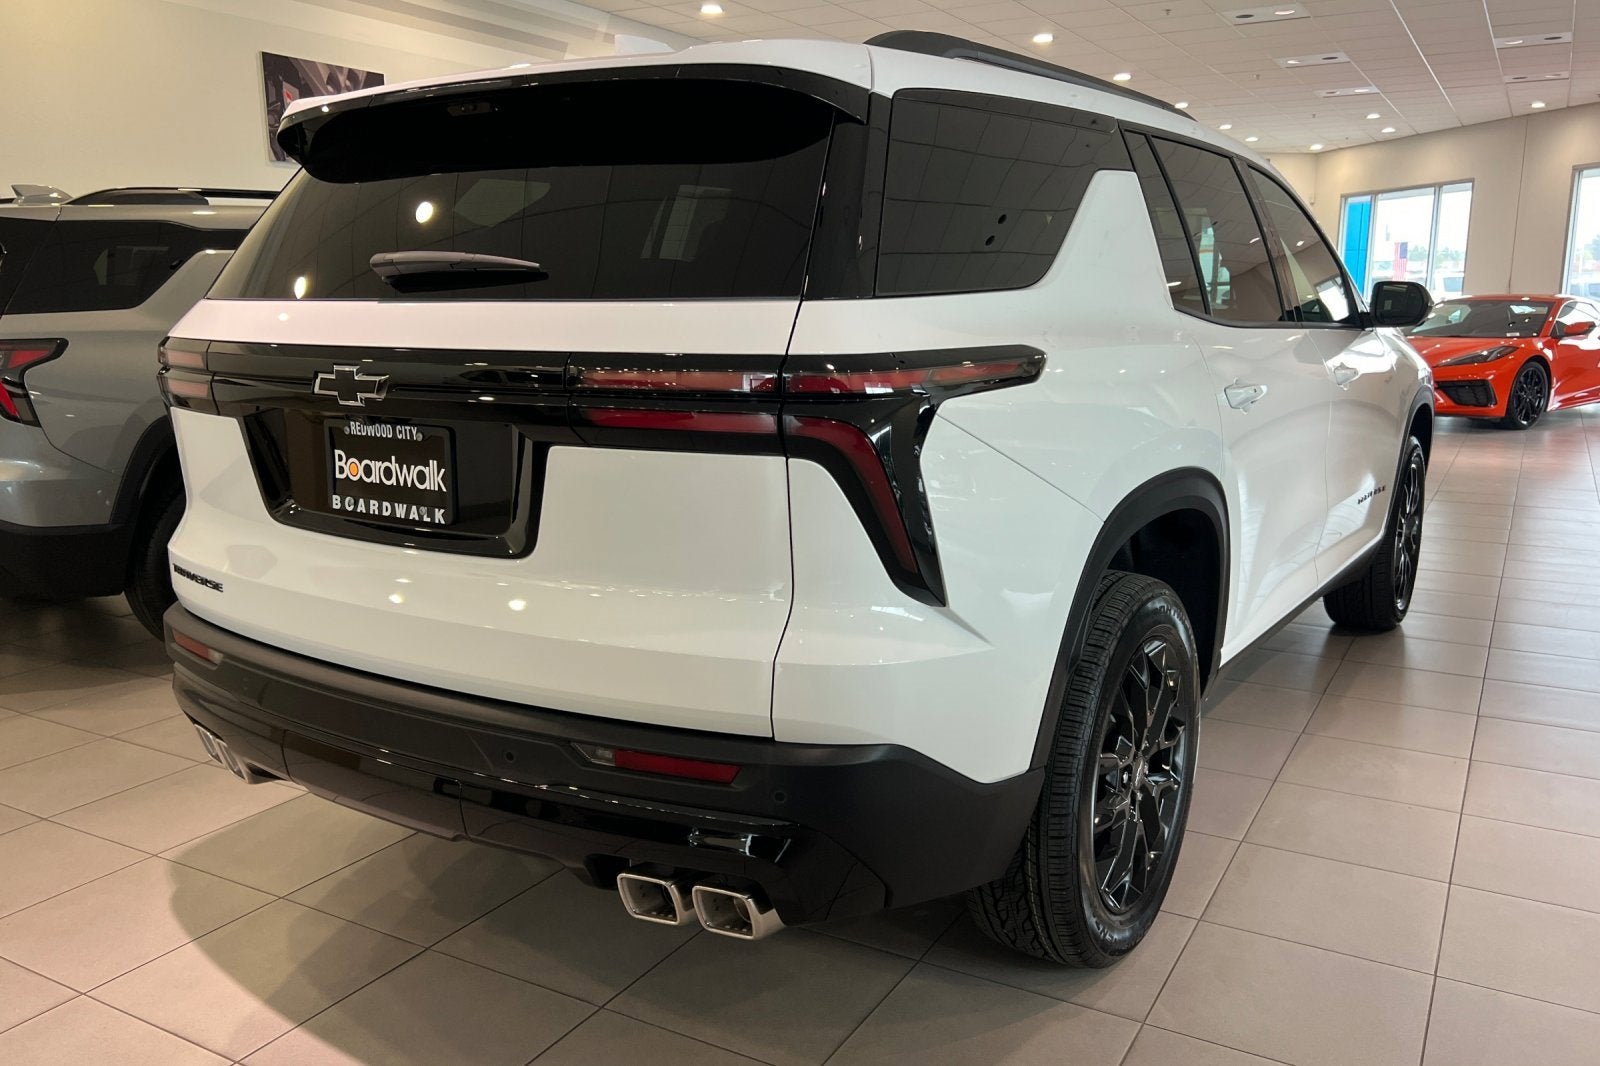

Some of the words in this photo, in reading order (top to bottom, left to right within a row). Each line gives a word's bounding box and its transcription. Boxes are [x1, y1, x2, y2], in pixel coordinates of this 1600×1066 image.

[349, 421, 393, 438] REDWOOD
[396, 425, 418, 440] CITY
[334, 449, 447, 492] Boardwalk
[332, 494, 446, 525] BOARDWALK
